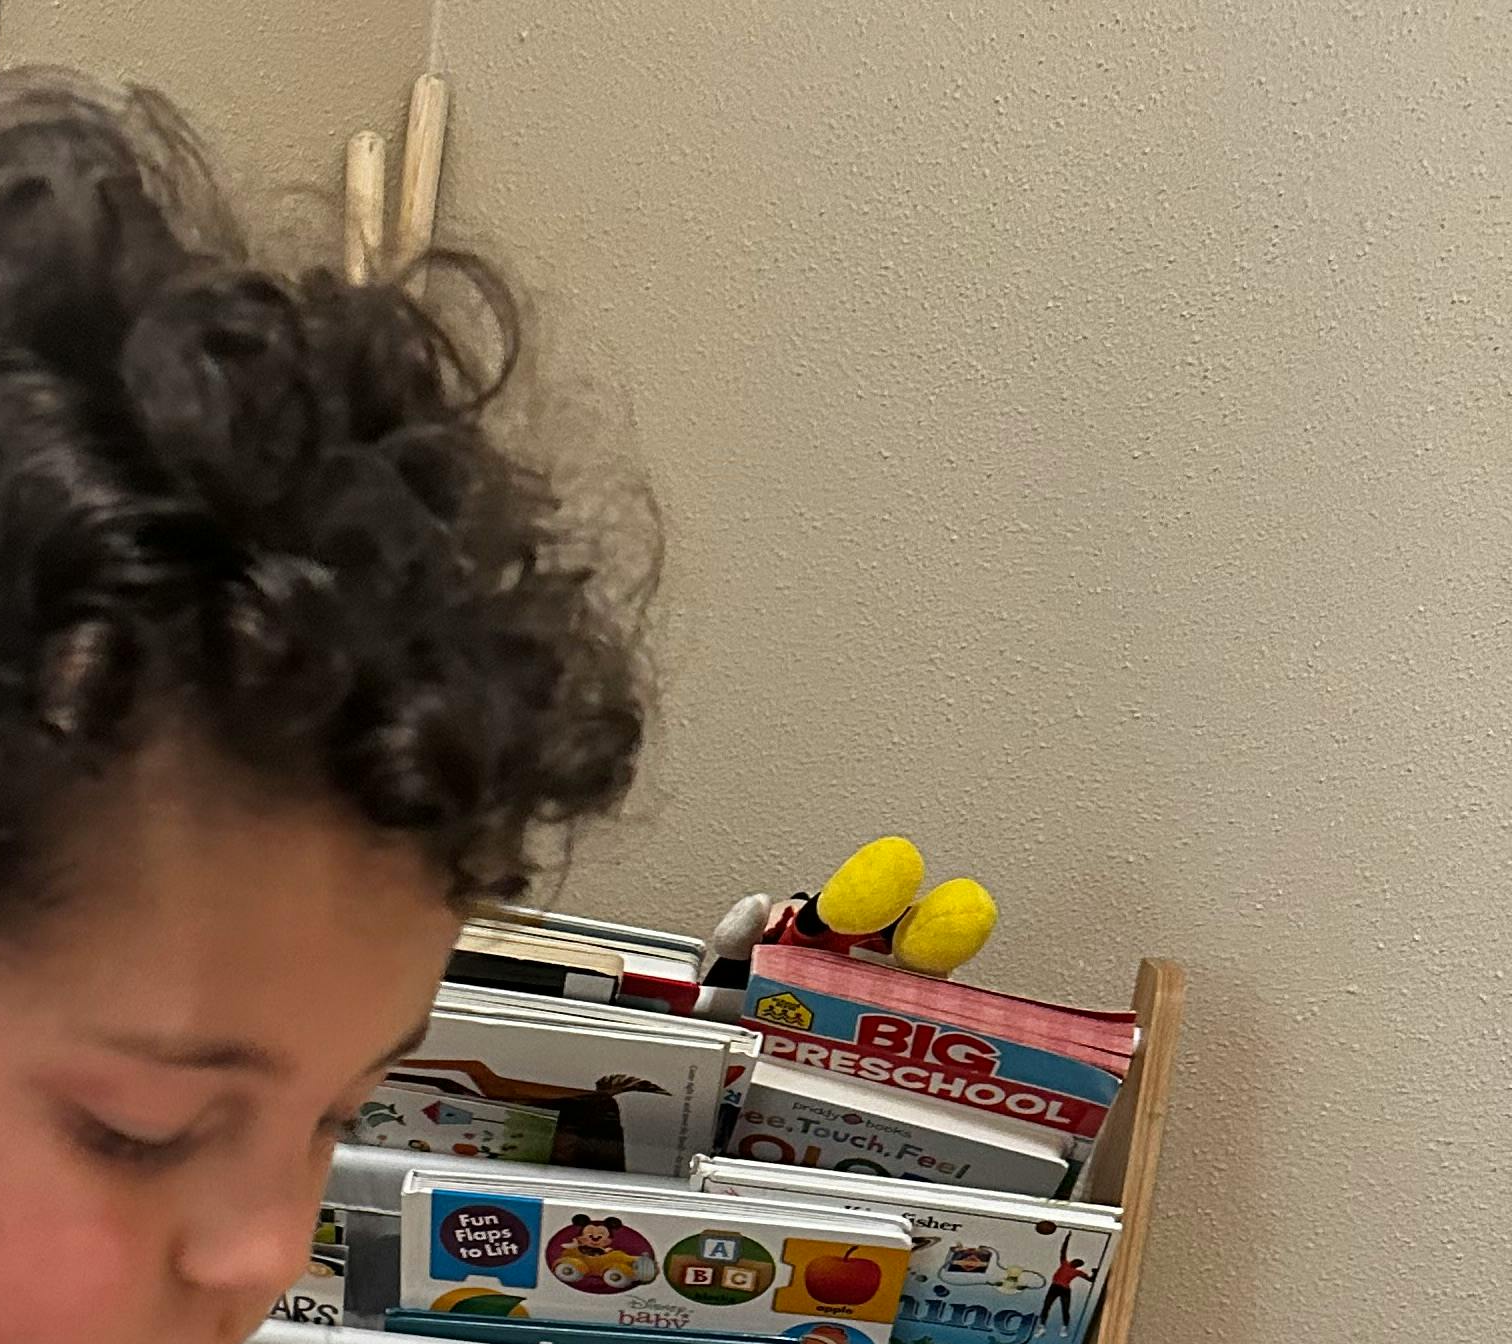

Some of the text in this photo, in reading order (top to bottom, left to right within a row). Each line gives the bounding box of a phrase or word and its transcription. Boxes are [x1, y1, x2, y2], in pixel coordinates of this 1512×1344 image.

[857, 1013, 1000, 1078] BIG
[763, 1034, 1073, 1125] PRESCHOOL
[865, 1120, 912, 1138] books
[895, 1143, 971, 1179] Feel
[458, 1214, 499, 1228] Fun
[454, 1228, 512, 1244] Flaps
[460, 1243, 519, 1259] to Lift
[711, 1241, 730, 1258] A
[692, 1269, 708, 1283] B
[815, 1305, 853, 1316] apple
